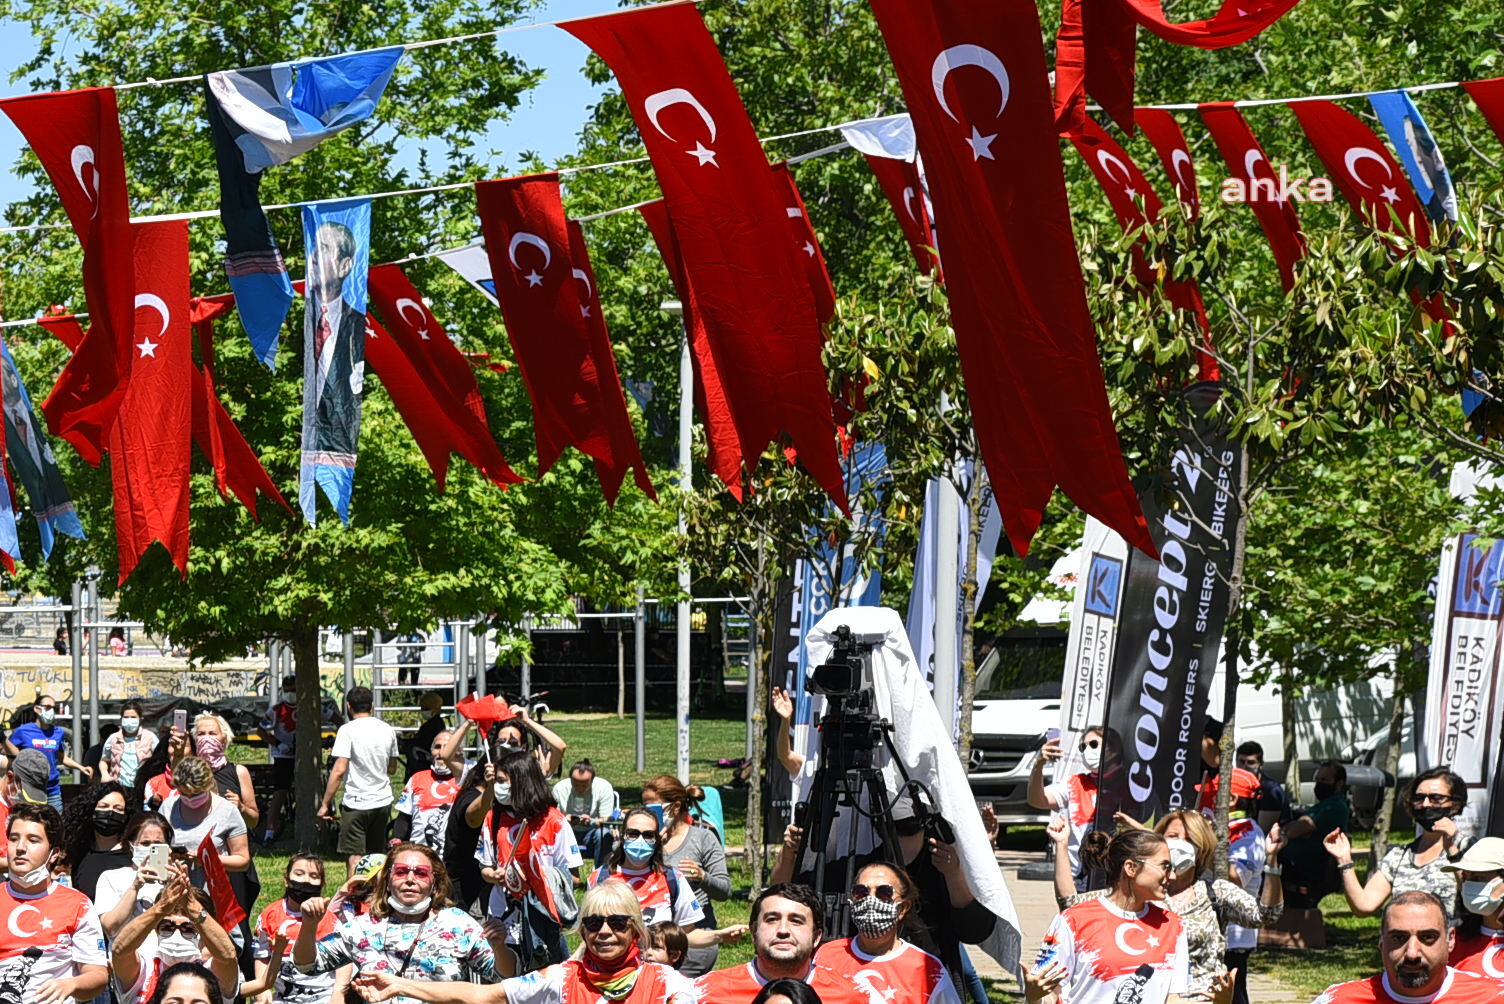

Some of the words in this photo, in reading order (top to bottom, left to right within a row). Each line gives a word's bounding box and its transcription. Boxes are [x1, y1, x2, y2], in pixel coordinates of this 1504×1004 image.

[1195, 561, 1217, 632] SKIERG
[1093, 628, 1109, 702] KADIKÖY
[1128, 508, 1193, 803] concept
[1460, 636, 1485, 740] KADIKÖY
[1178, 658, 1199, 742] ROWERS
[1169, 748, 1188, 811] DOOR
